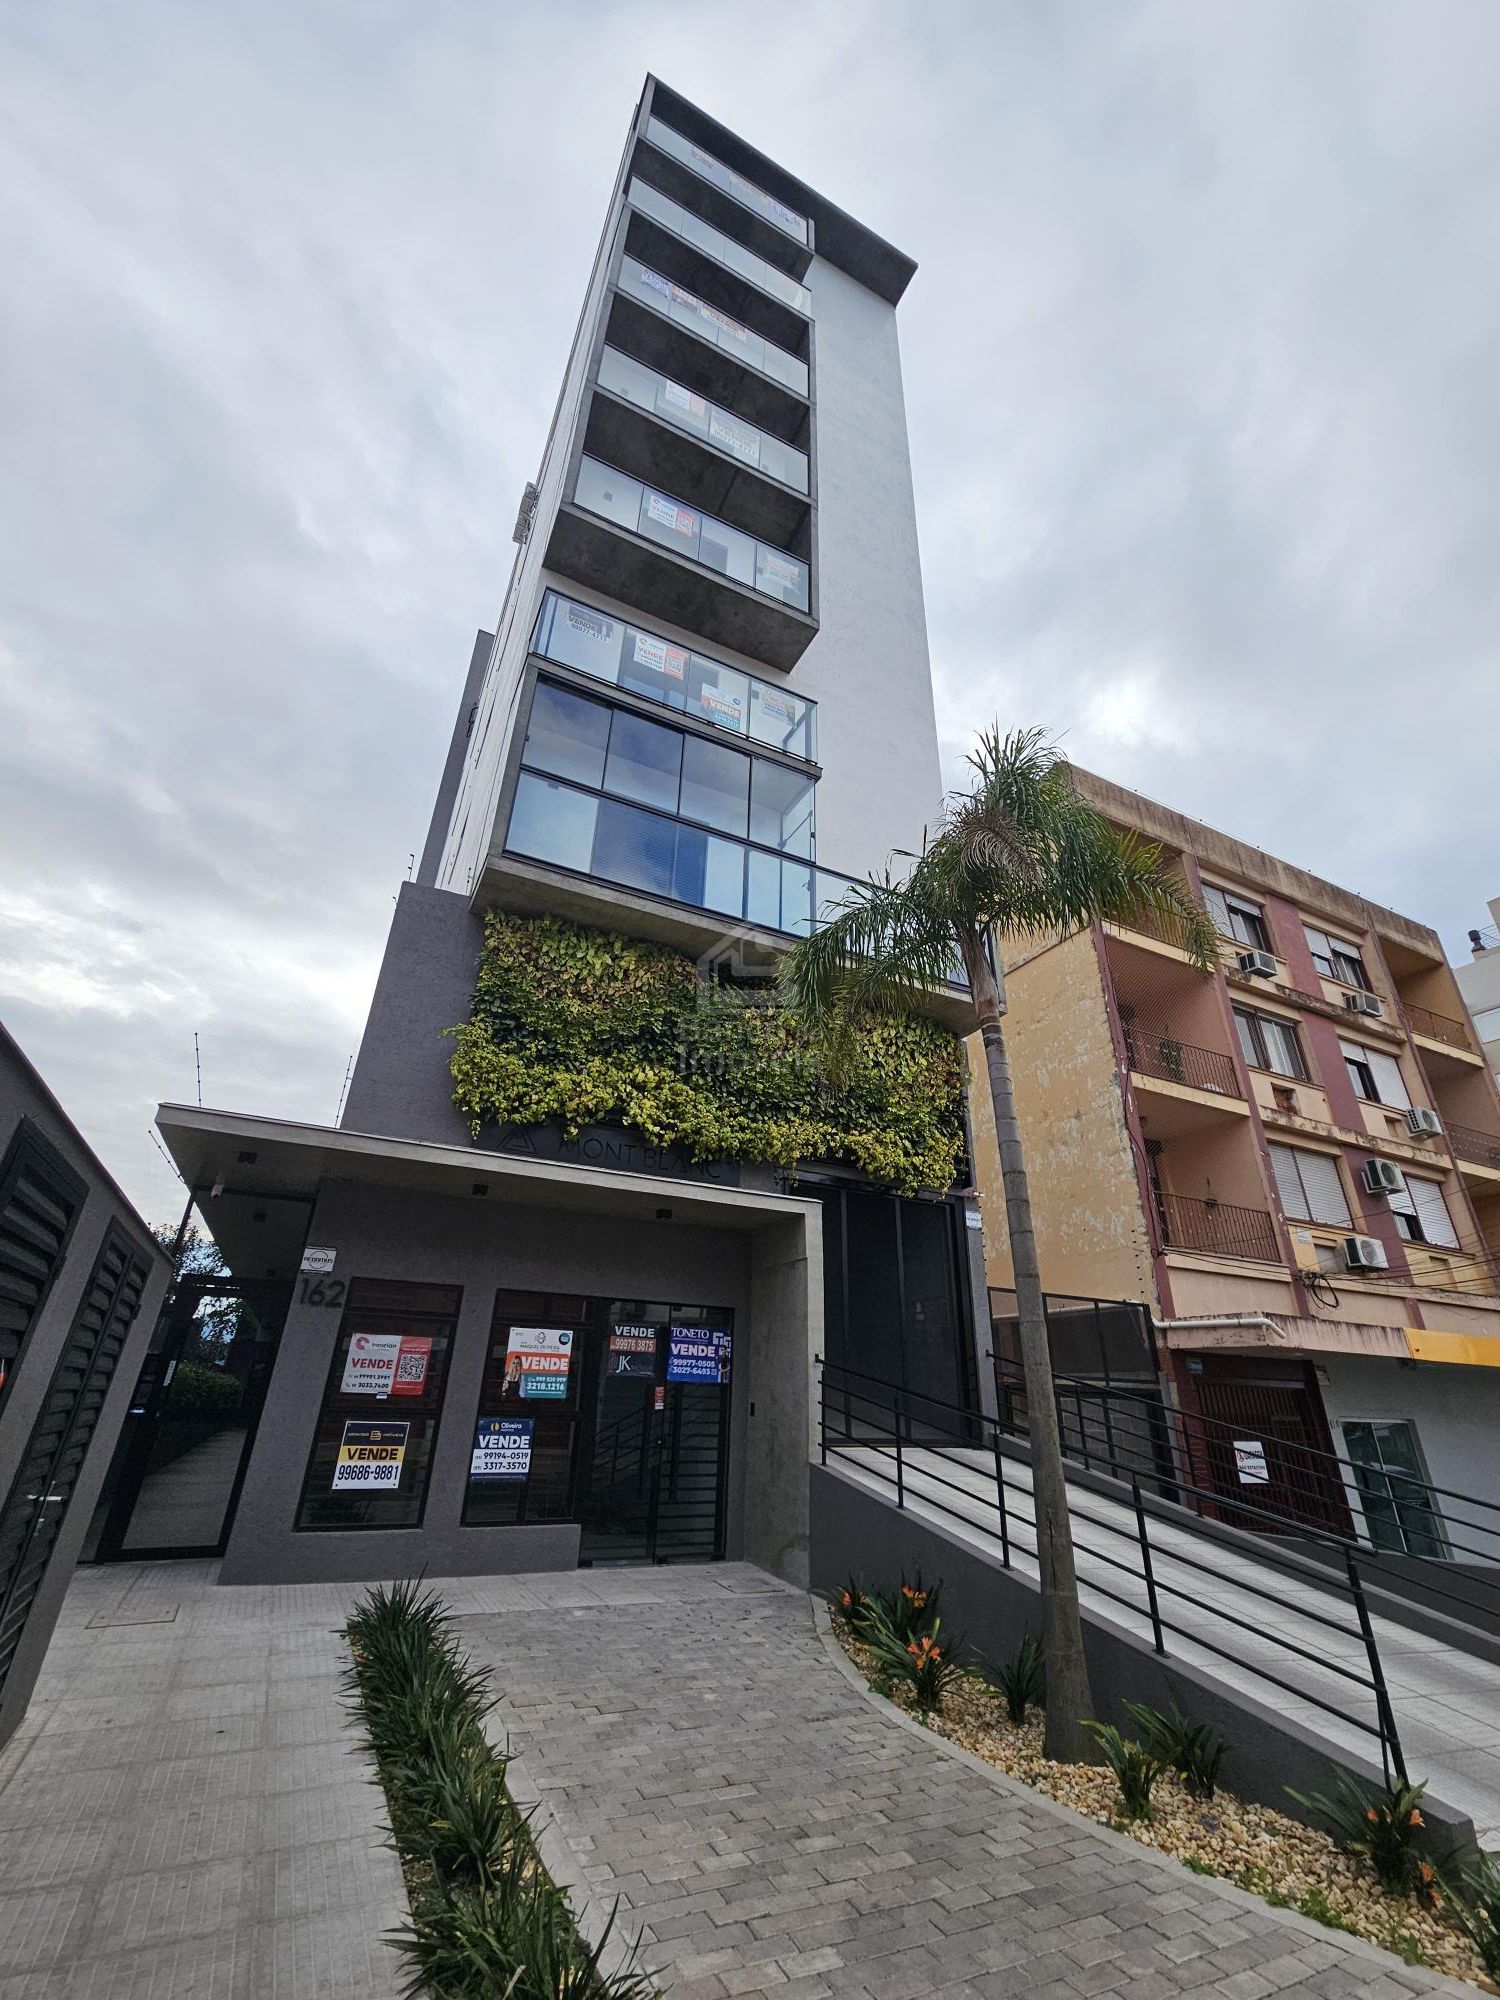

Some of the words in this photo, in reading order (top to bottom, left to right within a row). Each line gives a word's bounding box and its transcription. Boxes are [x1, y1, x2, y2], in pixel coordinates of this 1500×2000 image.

[709, 698, 740, 718] VENDE
[558, 1137, 637, 1167] MONT
[299, 1277, 347, 1308] 162
[614, 1325, 656, 1338] VENDE
[671, 1327, 710, 1340] TONETO
[615, 1338, 637, 1350] 99976
[637, 1339, 654, 1352] 3875
[670, 1343, 716, 1358] VENDE
[351, 1356, 395, 1370] VENDE
[521, 1356, 569, 1371] VENDE
[615, 1355, 632, 1373] JK
[526, 1382, 565, 1391] 3218.1216
[478, 1434, 531, 1449] VENDE
[347, 1447, 399, 1461] VENDE
[483, 1452, 529, 1460] 99194-0519
[337, 1464, 399, 1481] 99686-9881
[483, 1461, 527, 1470] 3317-3570
